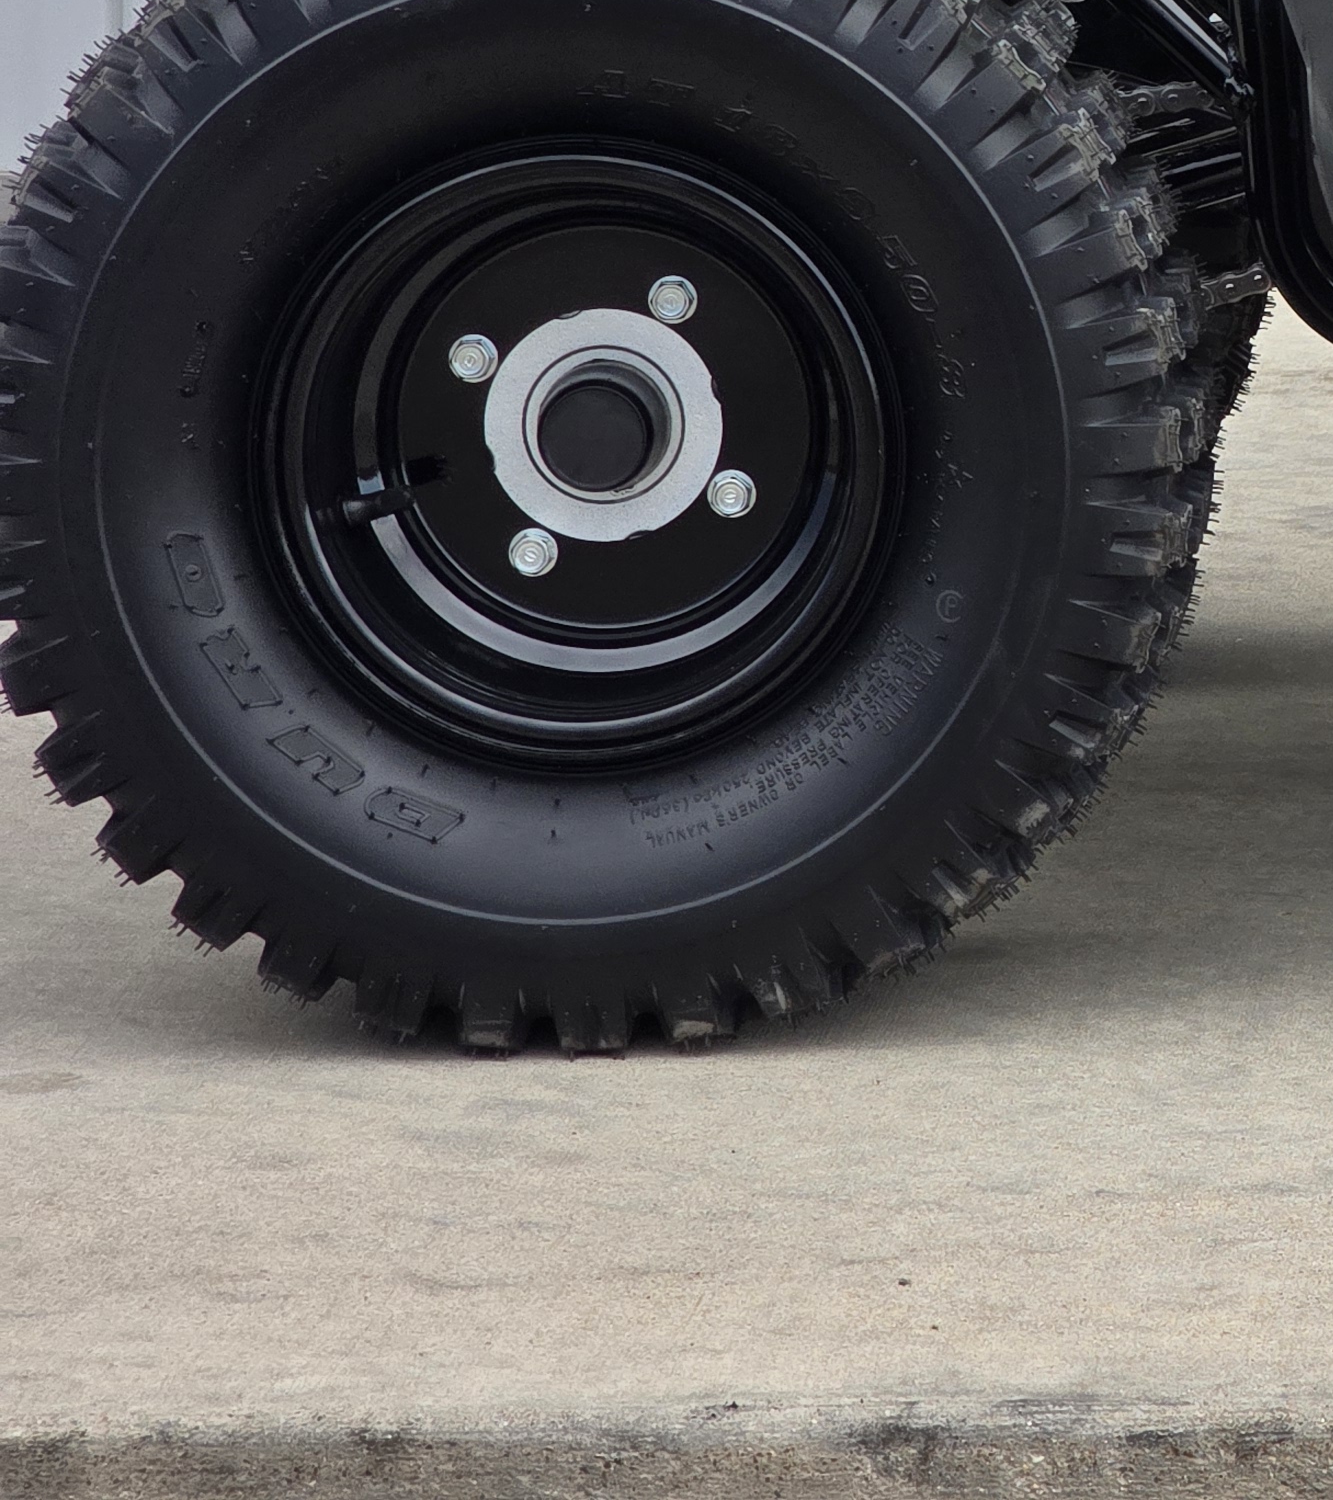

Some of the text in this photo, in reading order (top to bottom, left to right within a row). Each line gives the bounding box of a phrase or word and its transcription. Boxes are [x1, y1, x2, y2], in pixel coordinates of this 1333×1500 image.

[860, 649, 888, 683] NOT
[887, 632, 914, 666] FOR
[164, 531, 466, 844] DURO
[811, 678, 864, 736] INFLATE
[826, 664, 893, 743] OPERATING
[852, 671, 904, 735] VEHICLE
[871, 645, 944, 741] WARNING
[753, 728, 812, 779] BEYOND
[808, 729, 854, 775] LABEL
[781, 769, 807, 793] OR
[713, 783, 781, 831] OWNER'S
[644, 817, 712, 852] MANUAL
